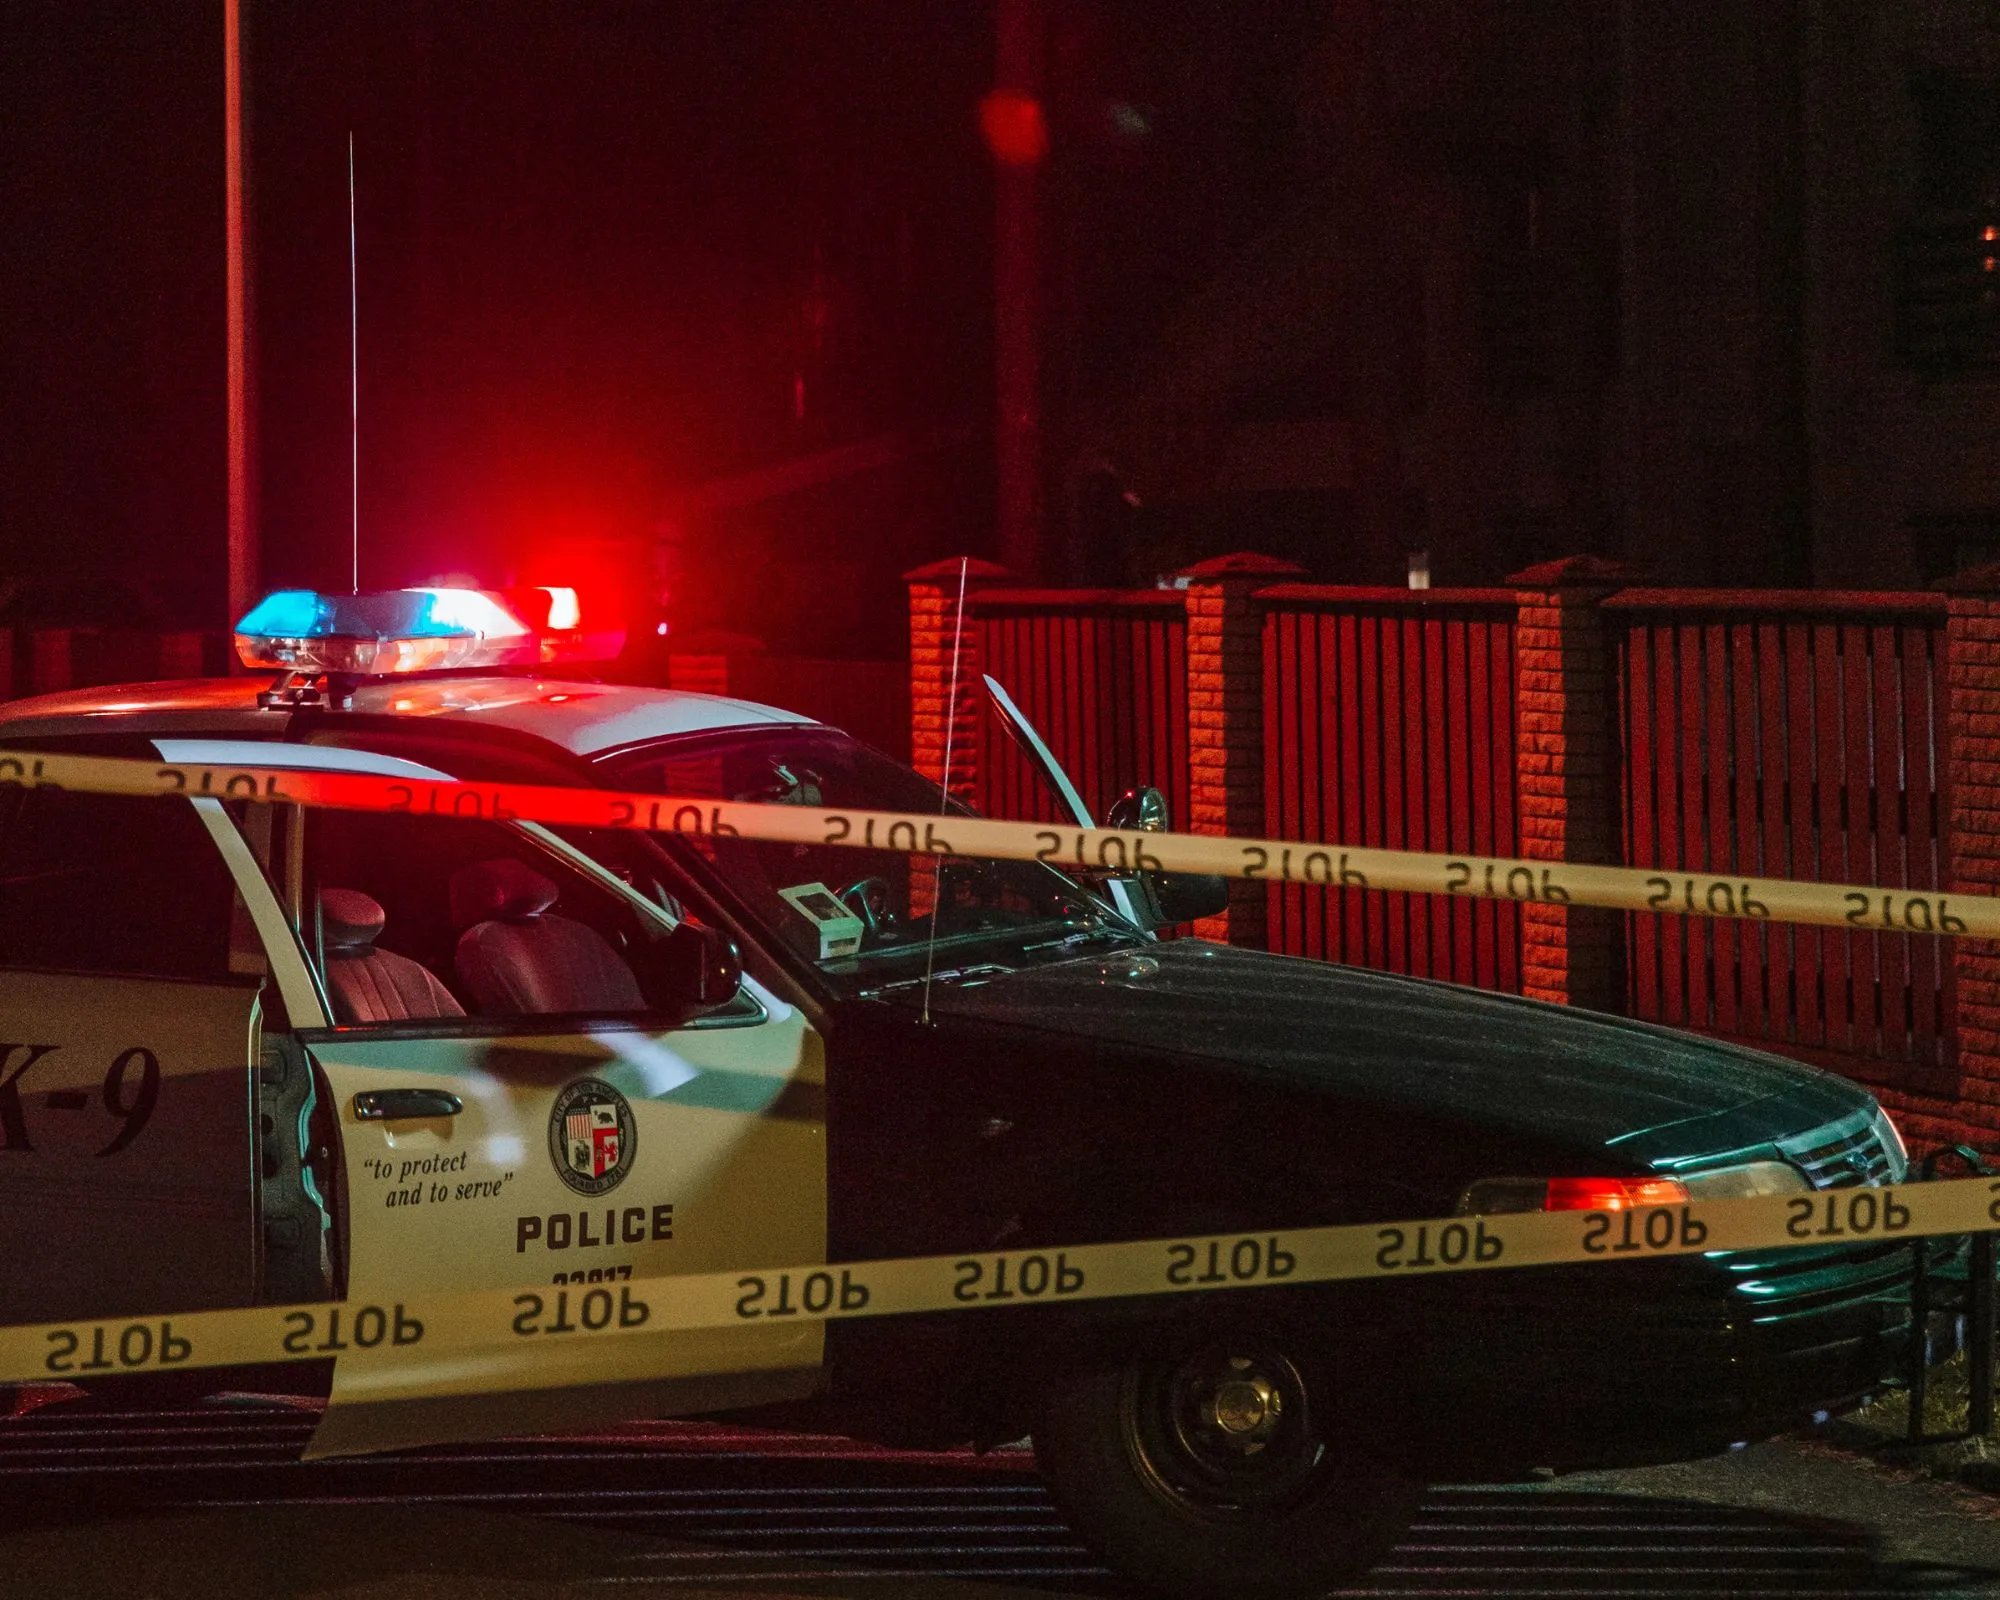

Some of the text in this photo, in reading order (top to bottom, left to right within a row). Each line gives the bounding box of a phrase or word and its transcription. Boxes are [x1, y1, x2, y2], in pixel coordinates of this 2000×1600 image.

[0, 1043, 160, 1157] K-9
[398, 1151, 467, 1183] protect
[386, 1182, 423, 1208] and
[430, 1182, 448, 1203] to
[516, 1204, 673, 1253] POLICE
